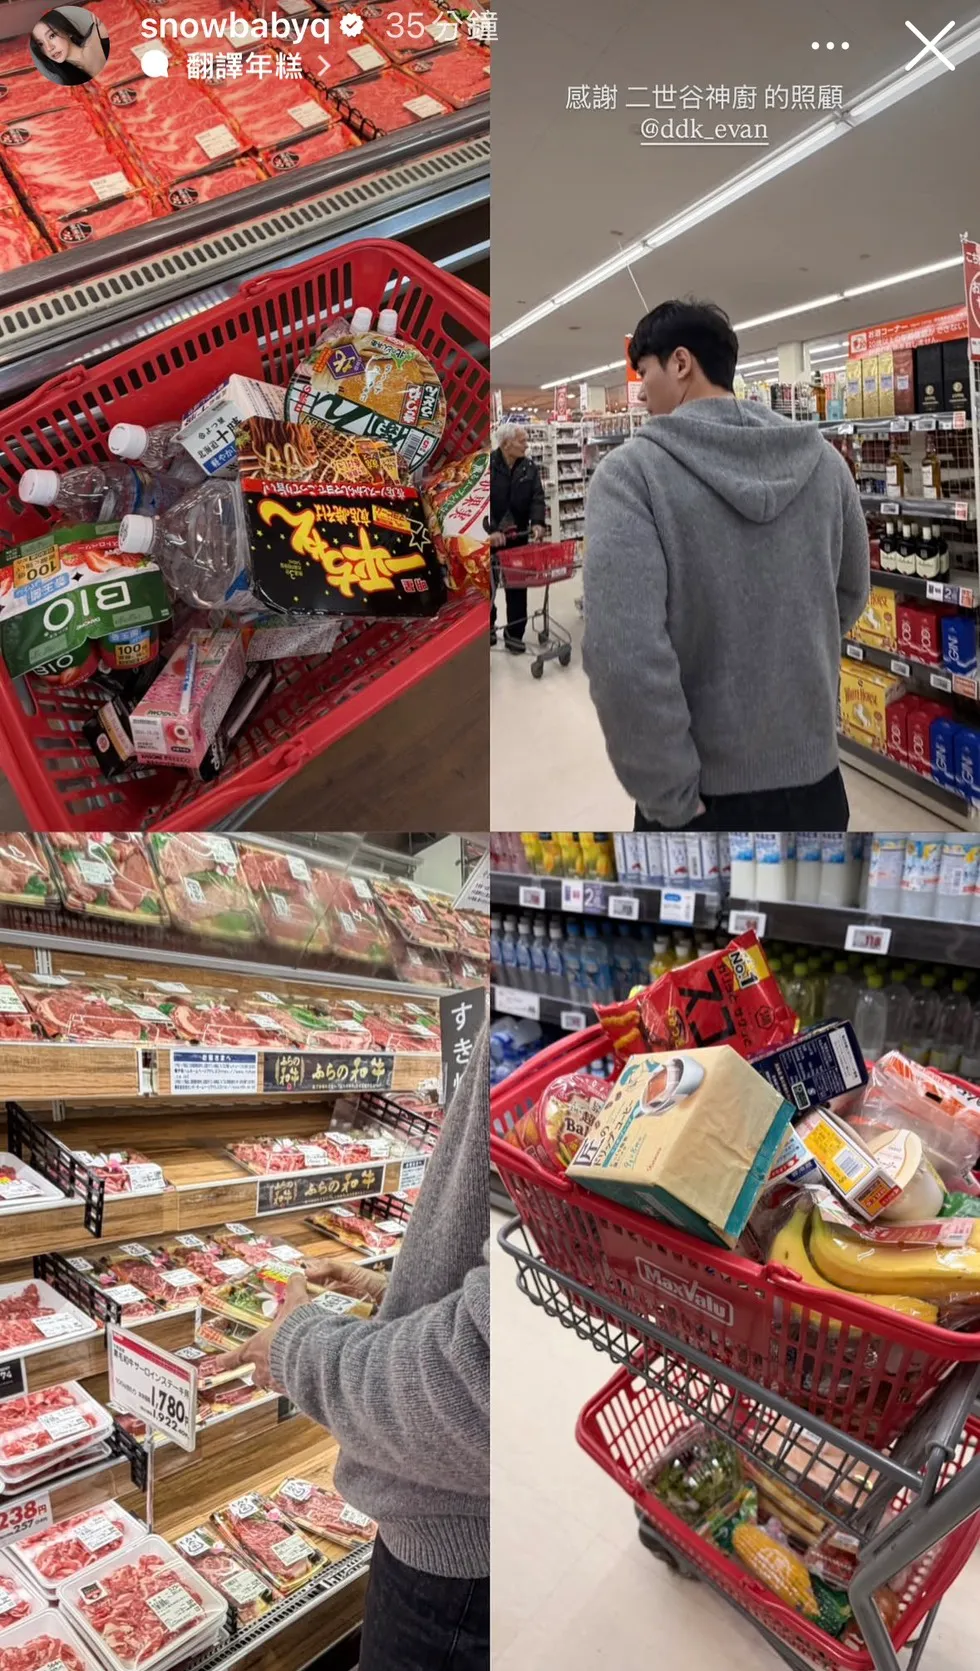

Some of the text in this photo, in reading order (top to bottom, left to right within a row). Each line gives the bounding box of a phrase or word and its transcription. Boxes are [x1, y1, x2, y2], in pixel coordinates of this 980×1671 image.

[401, 578, 429, 593] 明星
[43, 580, 131, 631] BIO
[730, 950, 759, 989] No.1
[312, 1056, 386, 1082] ふらの和牛
[304, 1169, 376, 1197] ふらの和牛
[643, 1263, 727, 1319] MaxValu
